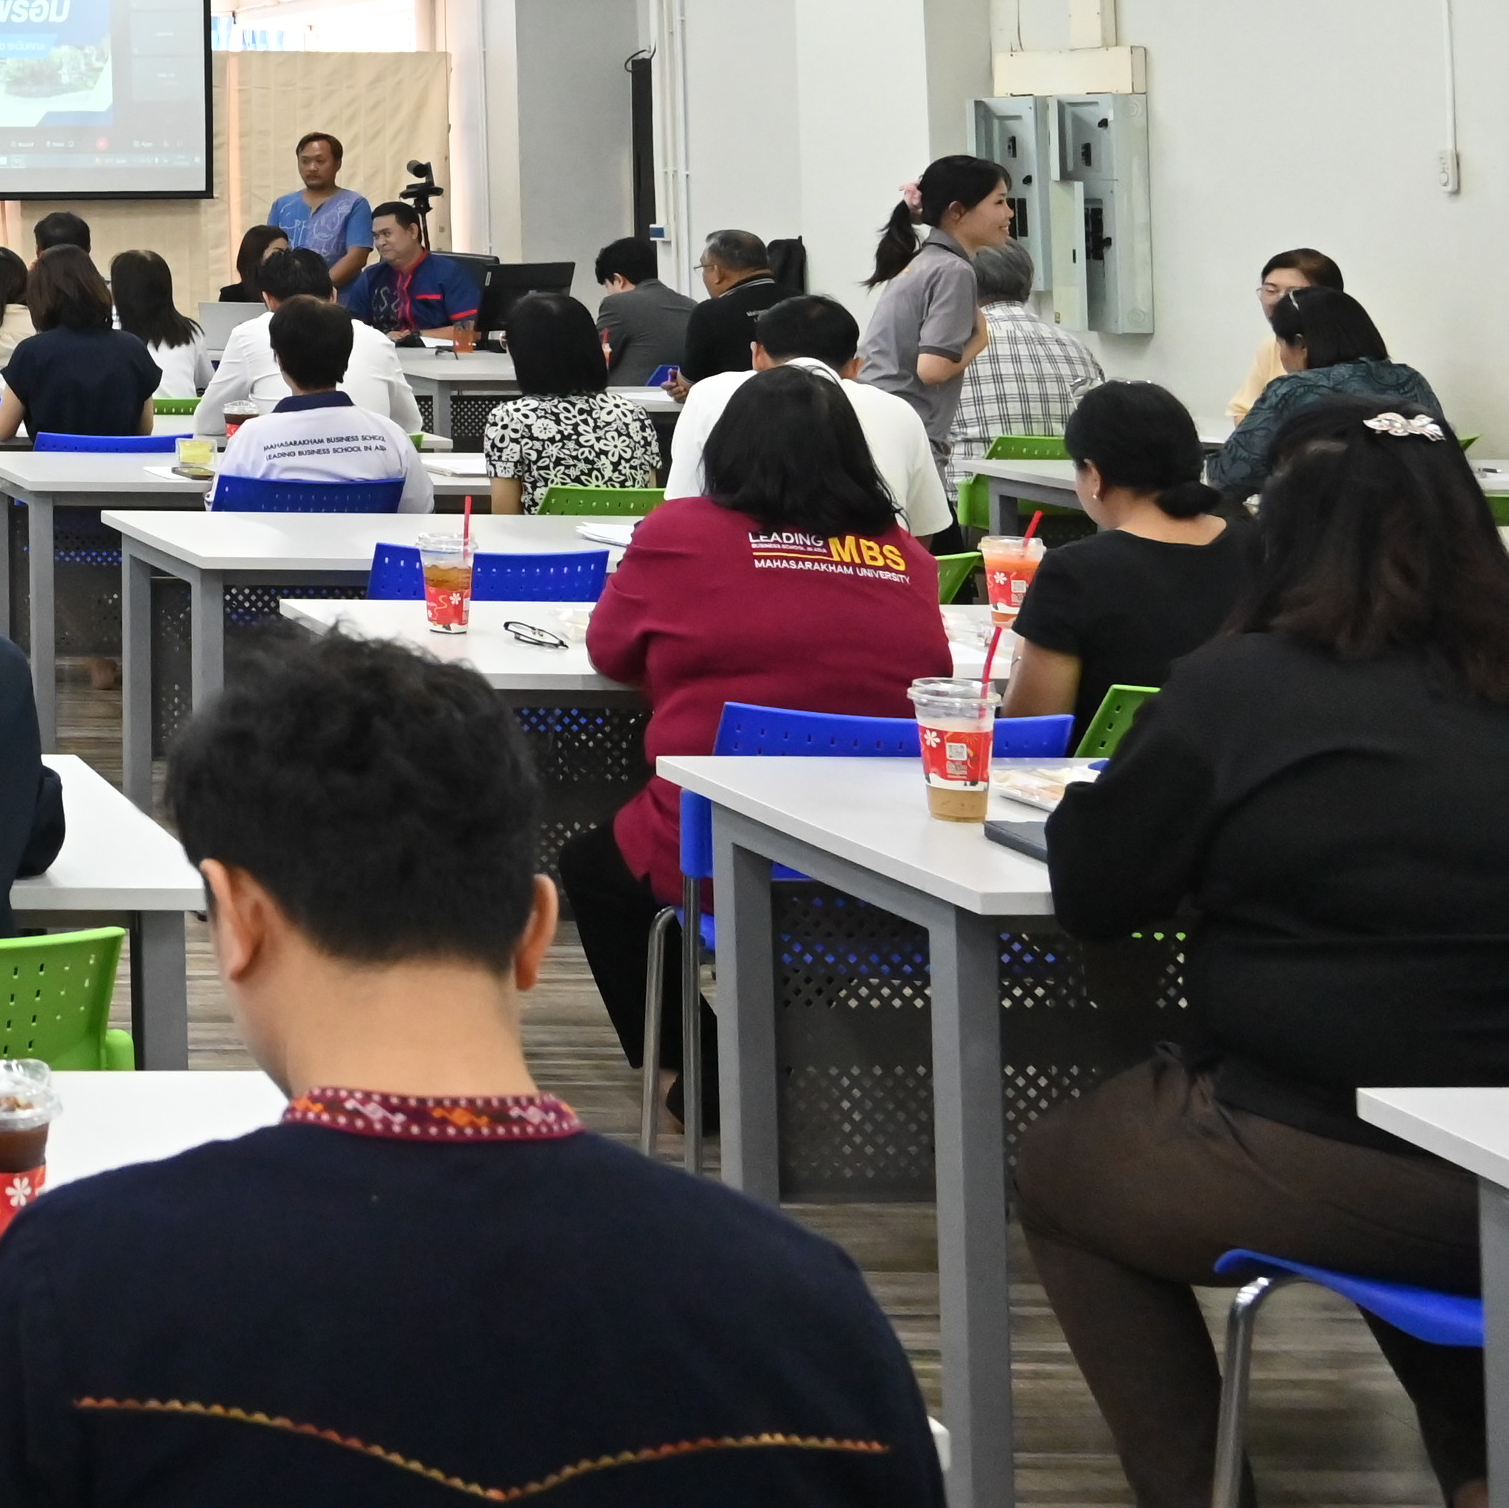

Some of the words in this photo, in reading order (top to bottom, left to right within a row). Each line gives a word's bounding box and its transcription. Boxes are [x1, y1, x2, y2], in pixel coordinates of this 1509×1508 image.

[263, 437, 325, 452] MAHASARAKHAM
[326, 435, 359, 444] BUSINESS
[266, 451, 296, 461] LEADING
[298, 448, 330, 457] BUSINESS
[748, 532, 824, 547] LEADING
[828, 535, 907, 571] MBS
[753, 559, 854, 575] MAHASARAKHAM
[856, 567, 911, 584] UNIVERSITY
